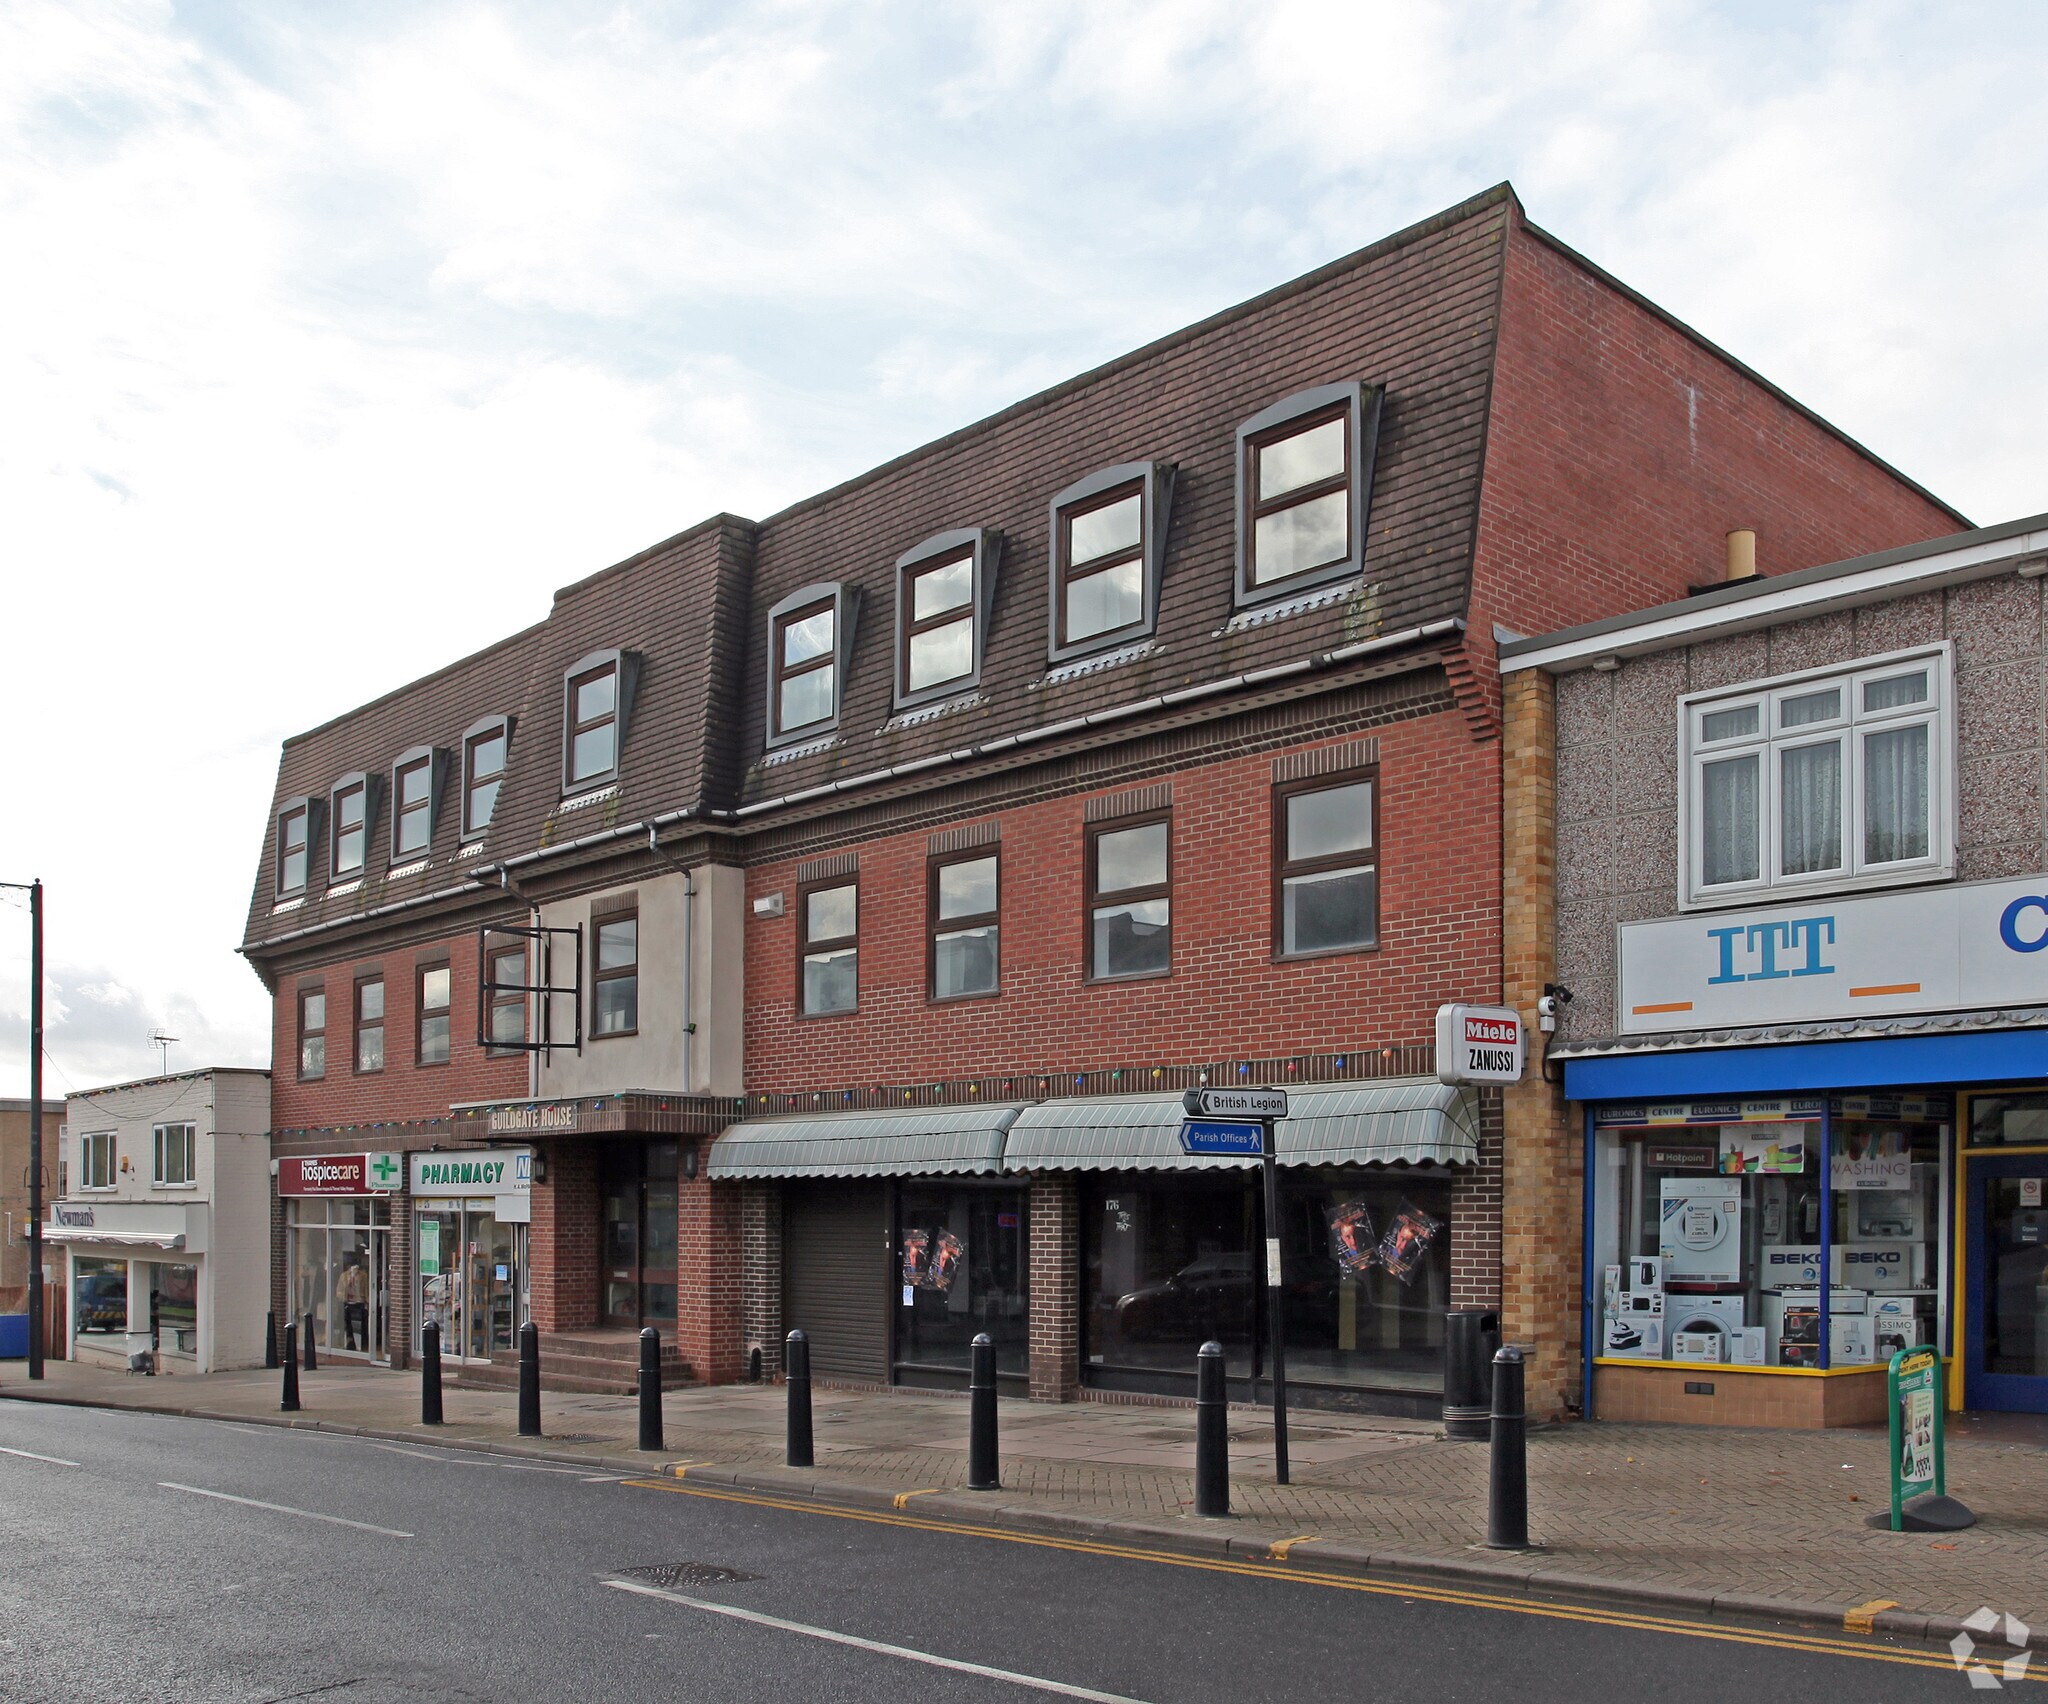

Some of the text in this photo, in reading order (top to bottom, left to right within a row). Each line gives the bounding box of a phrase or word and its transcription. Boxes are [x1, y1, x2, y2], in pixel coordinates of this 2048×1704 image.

[1707, 916, 1835, 985] ITT
[1466, 1021, 1516, 1041] Miele
[1469, 1048, 1514, 1072] ZANUSSI
[1213, 1096, 1283, 1111] British Legion
[1601, 1108, 1645, 1119] EURONICS
[1652, 1106, 1684, 1117] CENTRE
[1693, 1104, 1739, 1115] EURONICS
[1747, 1102, 1782, 1112] CENTRE
[491, 1106, 572, 1130] GUILDGATE HOUSE
[1194, 1131, 1248, 1144] Parish Offices
[1665, 1152, 1706, 1163] Hotpoint
[301, 1160, 360, 1187] hospicecare
[421, 1161, 505, 1184] PHARMACY
[1105, 1200, 1120, 1211] 176
[55, 1205, 95, 1228] Newman's
[1845, 1251, 1900, 1264] BEKO
[1879, 1321, 1912, 1329] SSIMO
